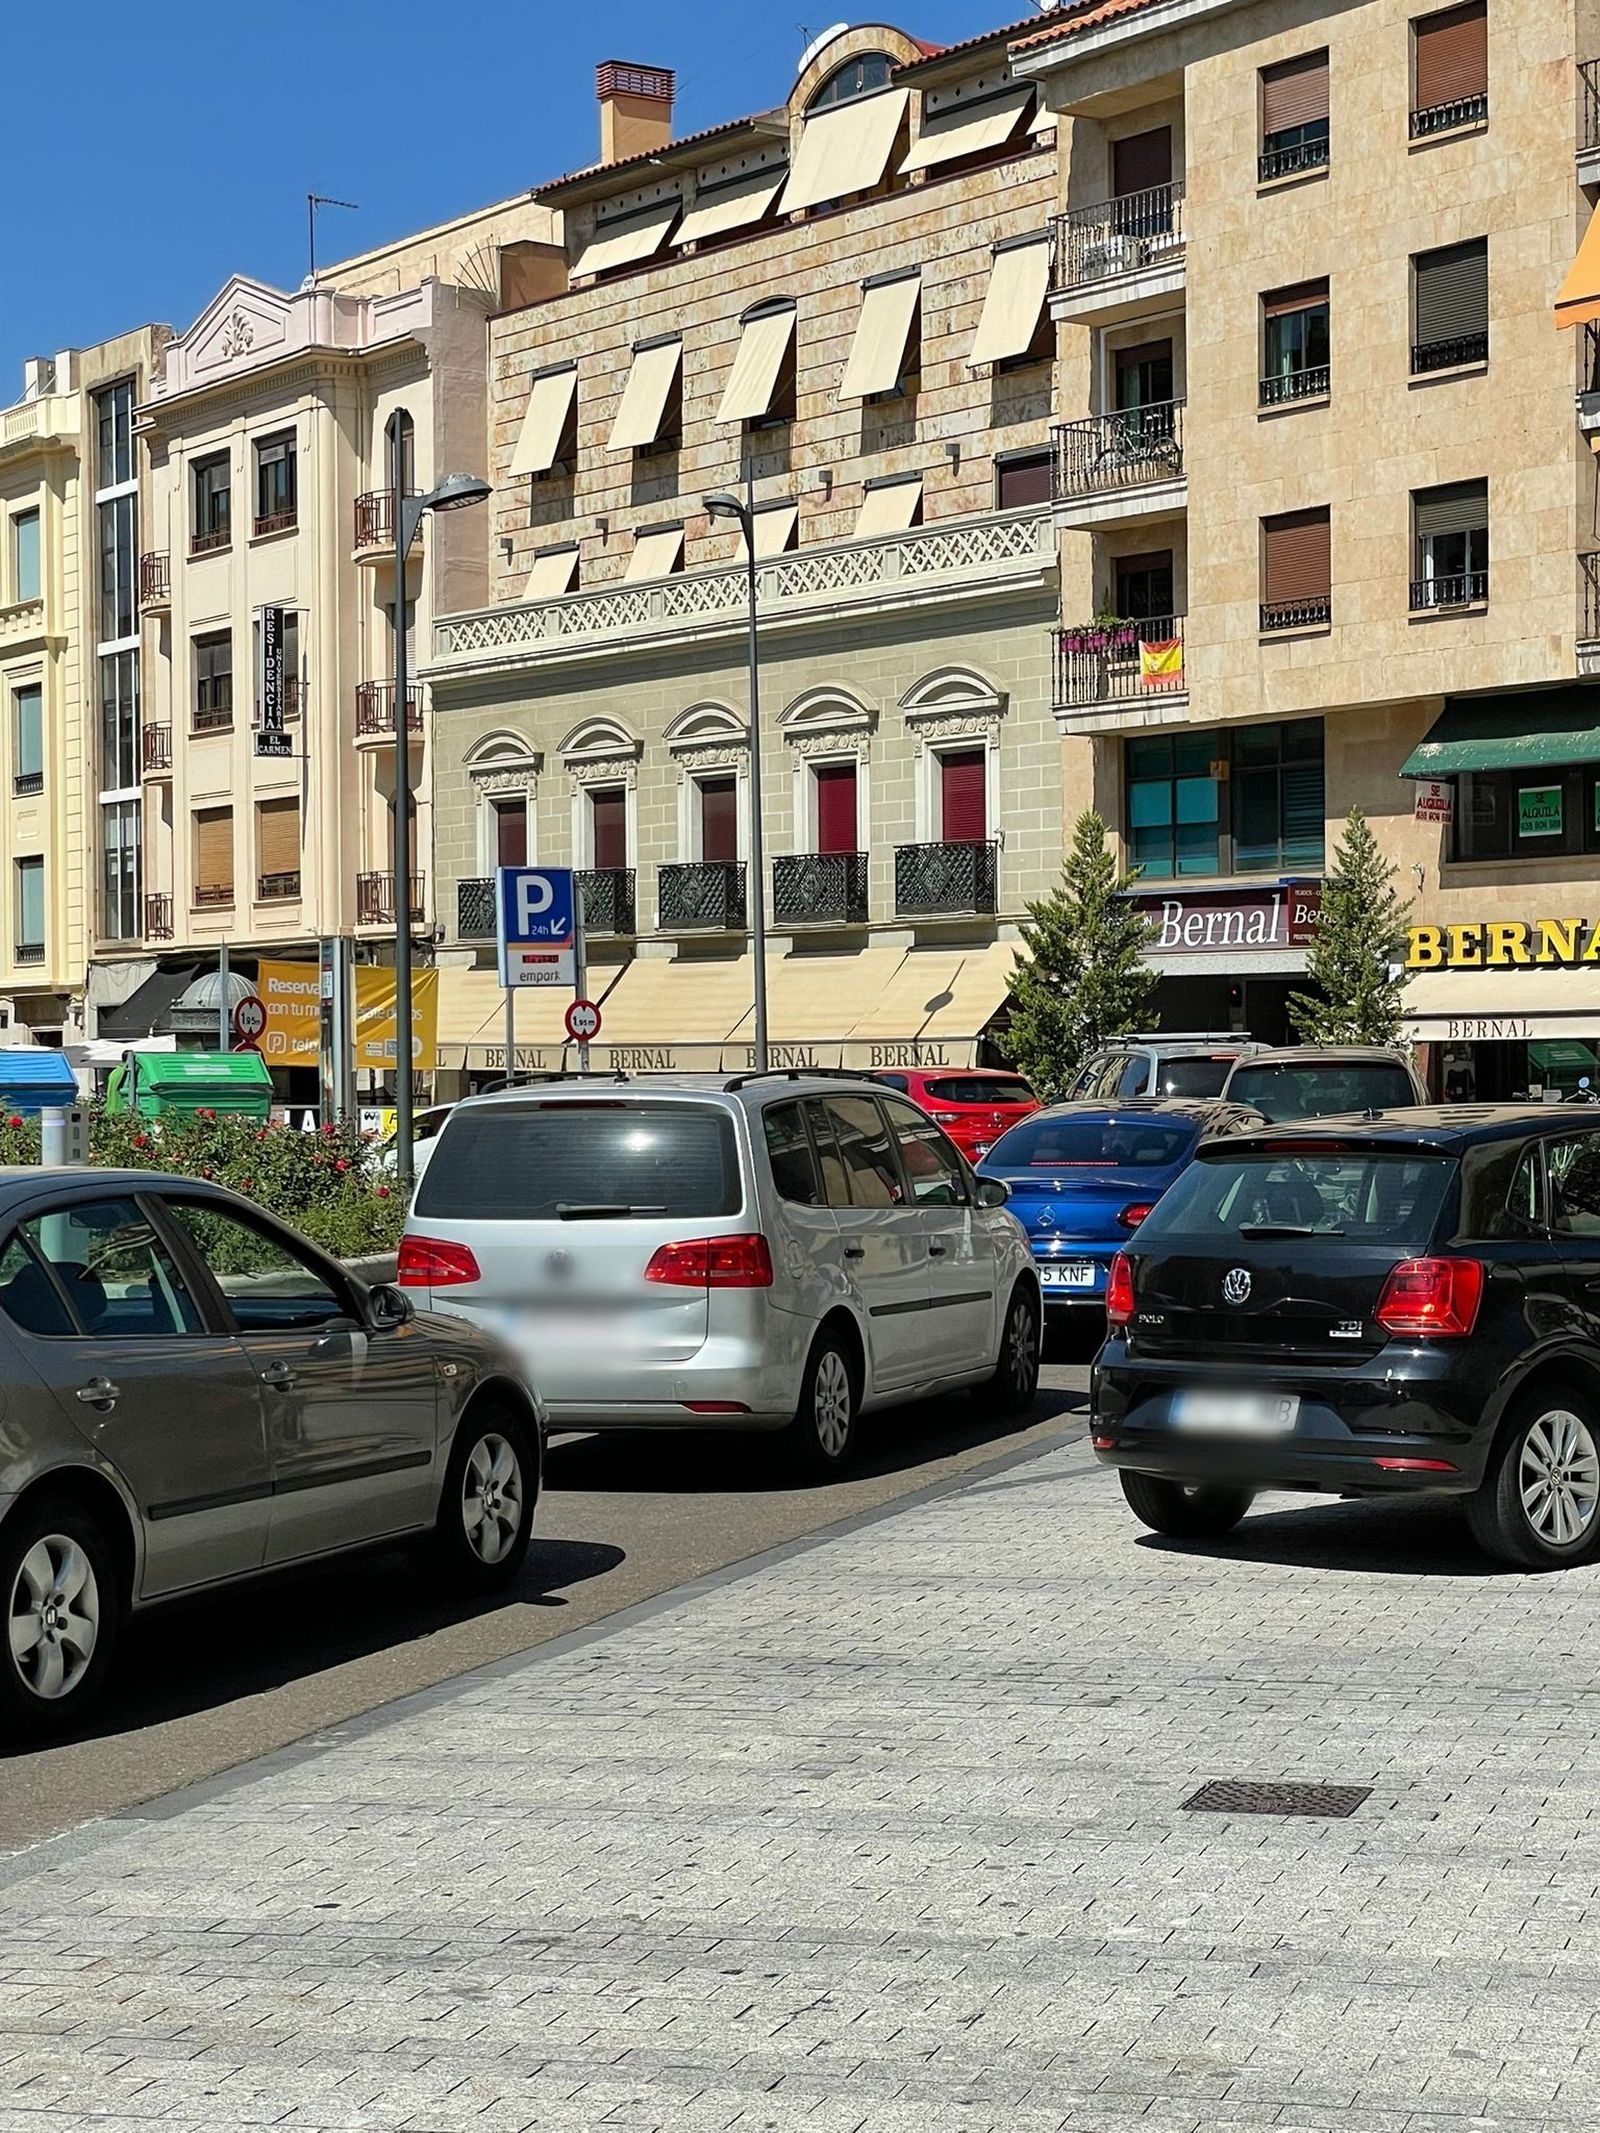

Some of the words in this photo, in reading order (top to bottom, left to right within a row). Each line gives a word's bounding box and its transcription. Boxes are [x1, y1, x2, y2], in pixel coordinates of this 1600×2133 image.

[265, 608, 275, 730] RESIDENCIA
[269, 735, 281, 745] EL
[258, 745, 292, 755] CARMEN
[1416, 797, 1452, 811] ALQUILA
[1522, 805, 1560, 818] ALQUILA
[516, 875, 554, 936] P
[1157, 893, 1281, 948] Bernal
[531, 925, 549, 935] 24h
[519, 970, 561, 983] empark
[267, 1003, 289, 1015] con
[291, 1002, 304, 1016] tu
[1447, 1019, 1533, 1039] BERNAL
[485, 1050, 547, 1069] BENAL
[608, 1049, 676, 1069] BERNAL
[746, 1046, 819, 1068] BRNAL
[869, 1044, 950, 1067] BERNAL
[1058, 1266, 1091, 1282] KNF
[1138, 1313, 1165, 1325] POLO
[1338, 1320, 1363, 1331] TDI
